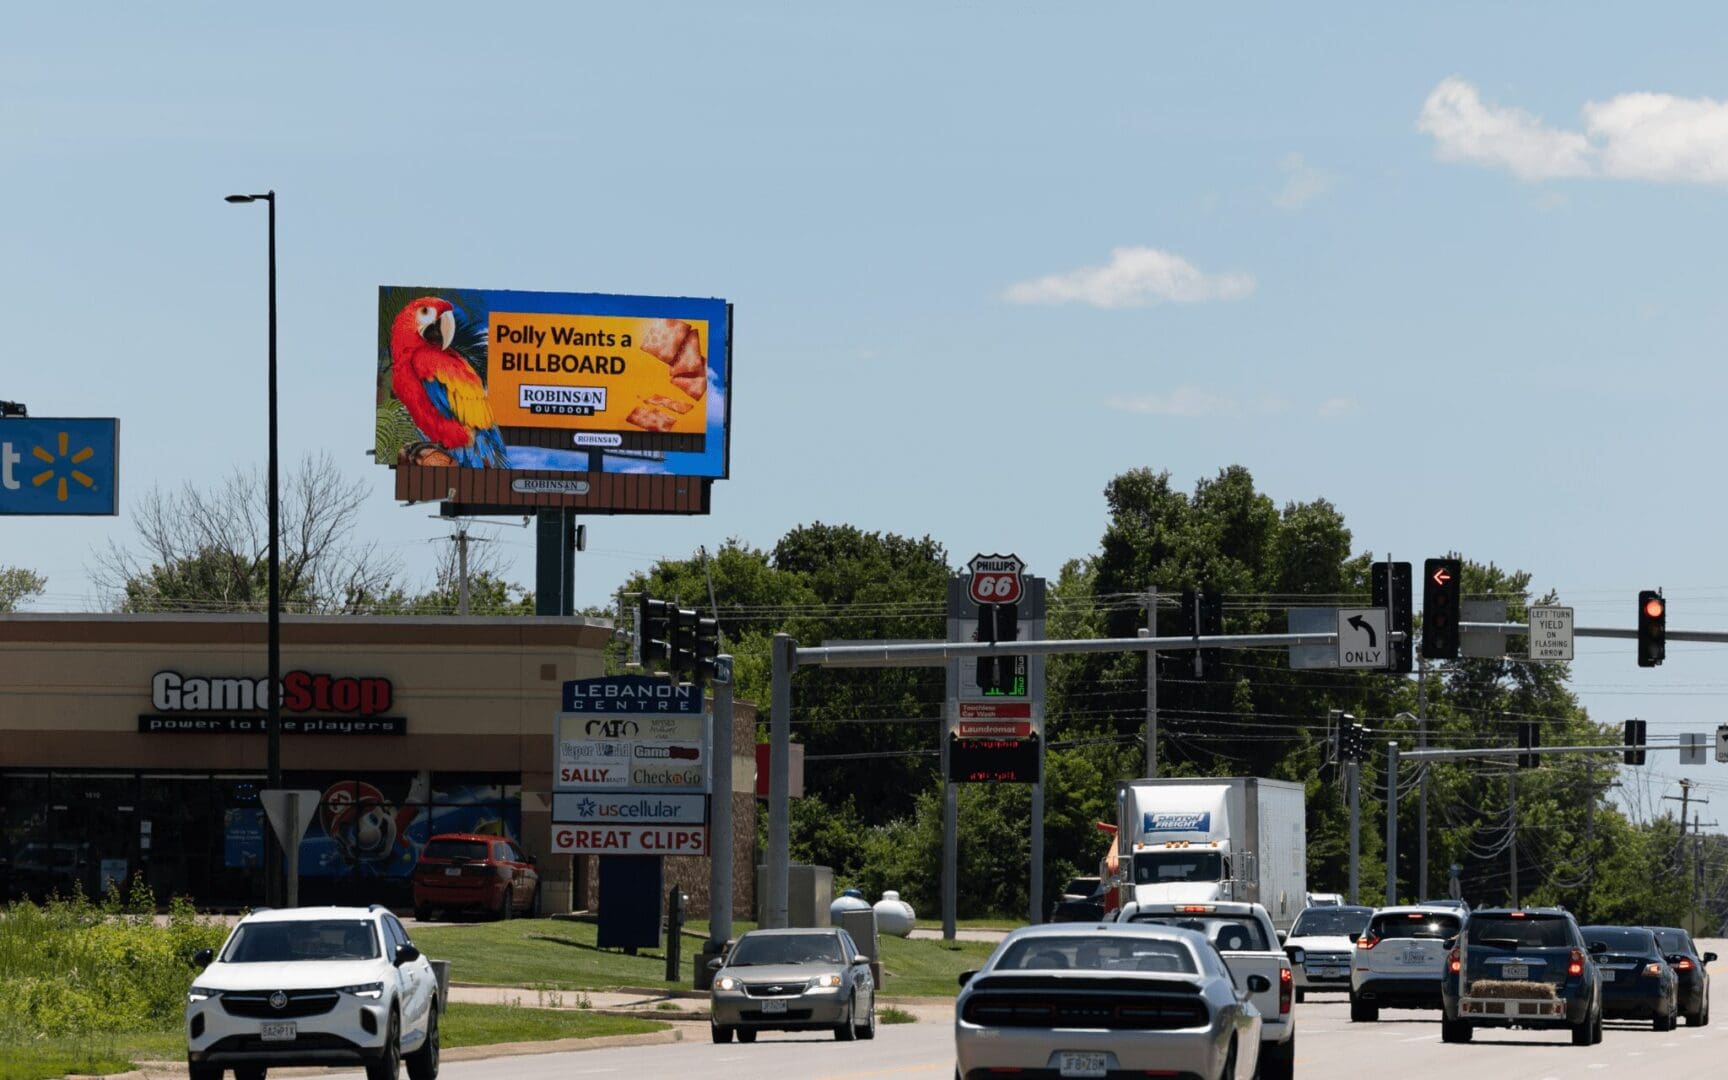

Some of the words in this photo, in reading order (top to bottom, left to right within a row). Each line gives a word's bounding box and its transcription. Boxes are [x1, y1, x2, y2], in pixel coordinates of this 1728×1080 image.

[496, 324, 546, 348] Polly
[551, 326, 615, 347] Wants
[621, 334, 632, 347] a
[502, 352, 626, 374] BILLBOARD
[523, 388, 603, 404] ROBINSON
[535, 405, 591, 414] OUTDOOR
[578, 435, 618, 444] ROBINSON
[524, 480, 579, 490] ROBINSON
[976, 561, 1016, 572] PHILLIPS
[978, 576, 1013, 597] 66
[1540, 620, 1563, 629] YIELD
[1535, 640, 1568, 648] FLASHING
[1345, 651, 1381, 662] ONLY
[153, 671, 392, 715] GameStop
[574, 684, 690, 698] LEBANON
[574, 700, 689, 711] CENTRE
[150, 720, 220, 729] power
[230, 719, 252, 729] to
[260, 719, 296, 729] te
[303, 720, 394, 732] players
[585, 720, 639, 737] CATO
[962, 725, 1016, 734] Laundromat
[561, 769, 609, 782] SALLY
[633, 769, 672, 784] Check
[599, 801, 682, 817] uscellular
[556, 830, 632, 848] GREAT
[639, 831, 703, 849] CLIPS
